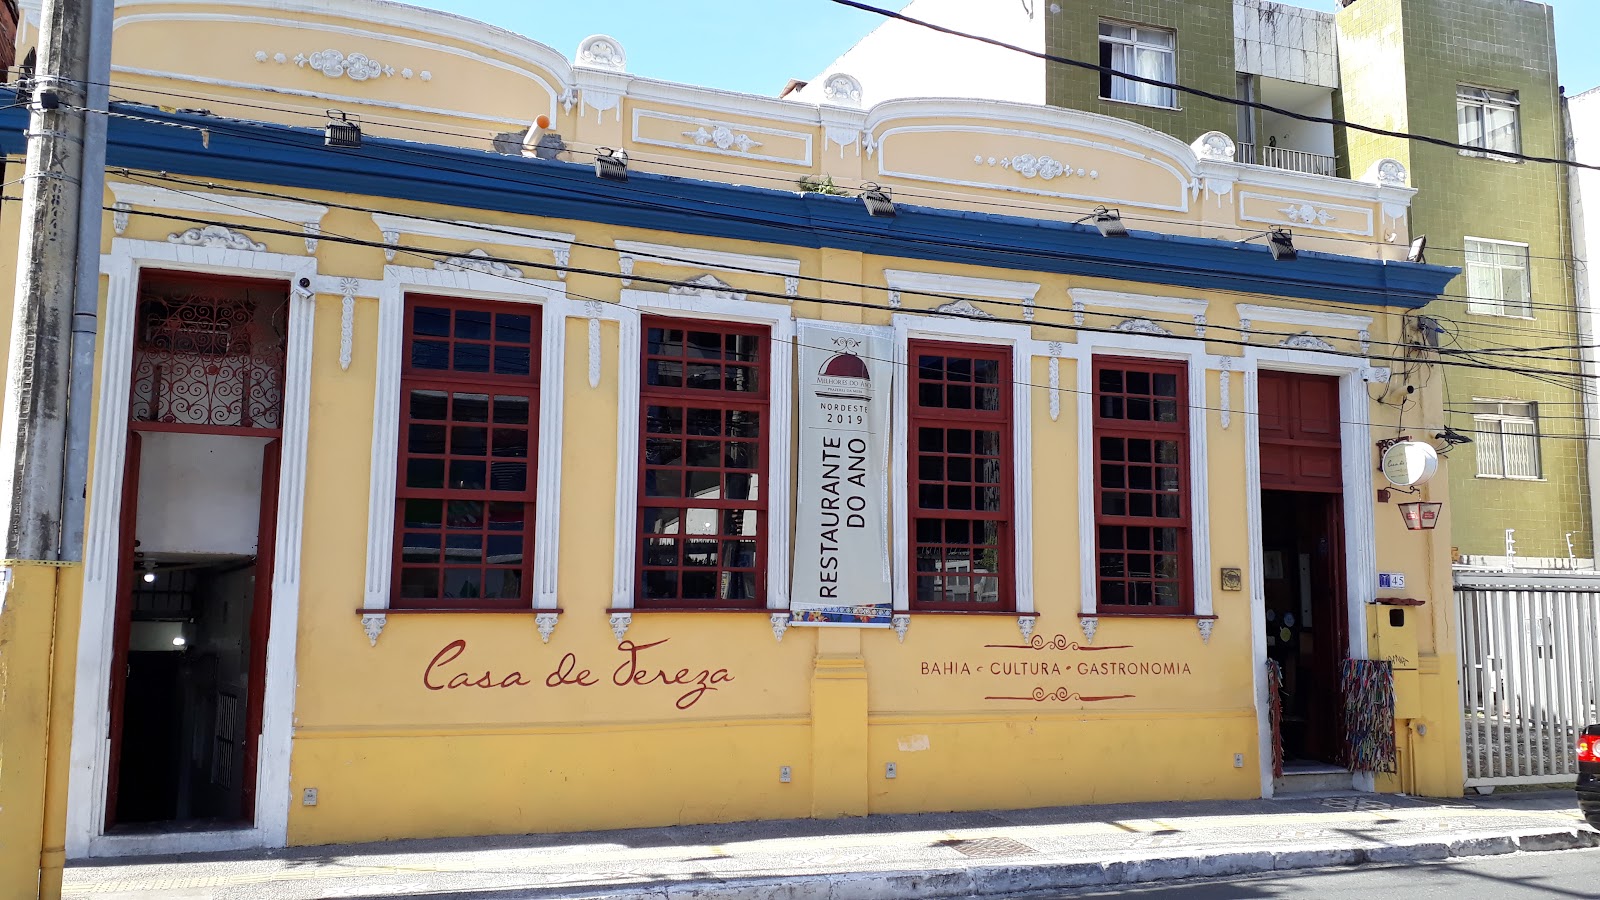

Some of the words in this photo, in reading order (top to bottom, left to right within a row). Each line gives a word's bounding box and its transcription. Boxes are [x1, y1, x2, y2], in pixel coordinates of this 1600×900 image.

[821, 403, 867, 414] NORDESTE
[828, 414, 862, 425] 2019
[847, 438, 866, 488] ANO
[819, 436, 841, 599] RESTAURANTE
[846, 495, 866, 528] DO
[1391, 576, 1404, 586] 45
[423, 639, 531, 691] Casa
[545, 652, 599, 688] de
[612, 637, 735, 710] Tereza
[920, 661, 971, 676] BAHIA
[989, 661, 1061, 676] CULTURA
[1077, 661, 1192, 676] GASTRONOMIA
